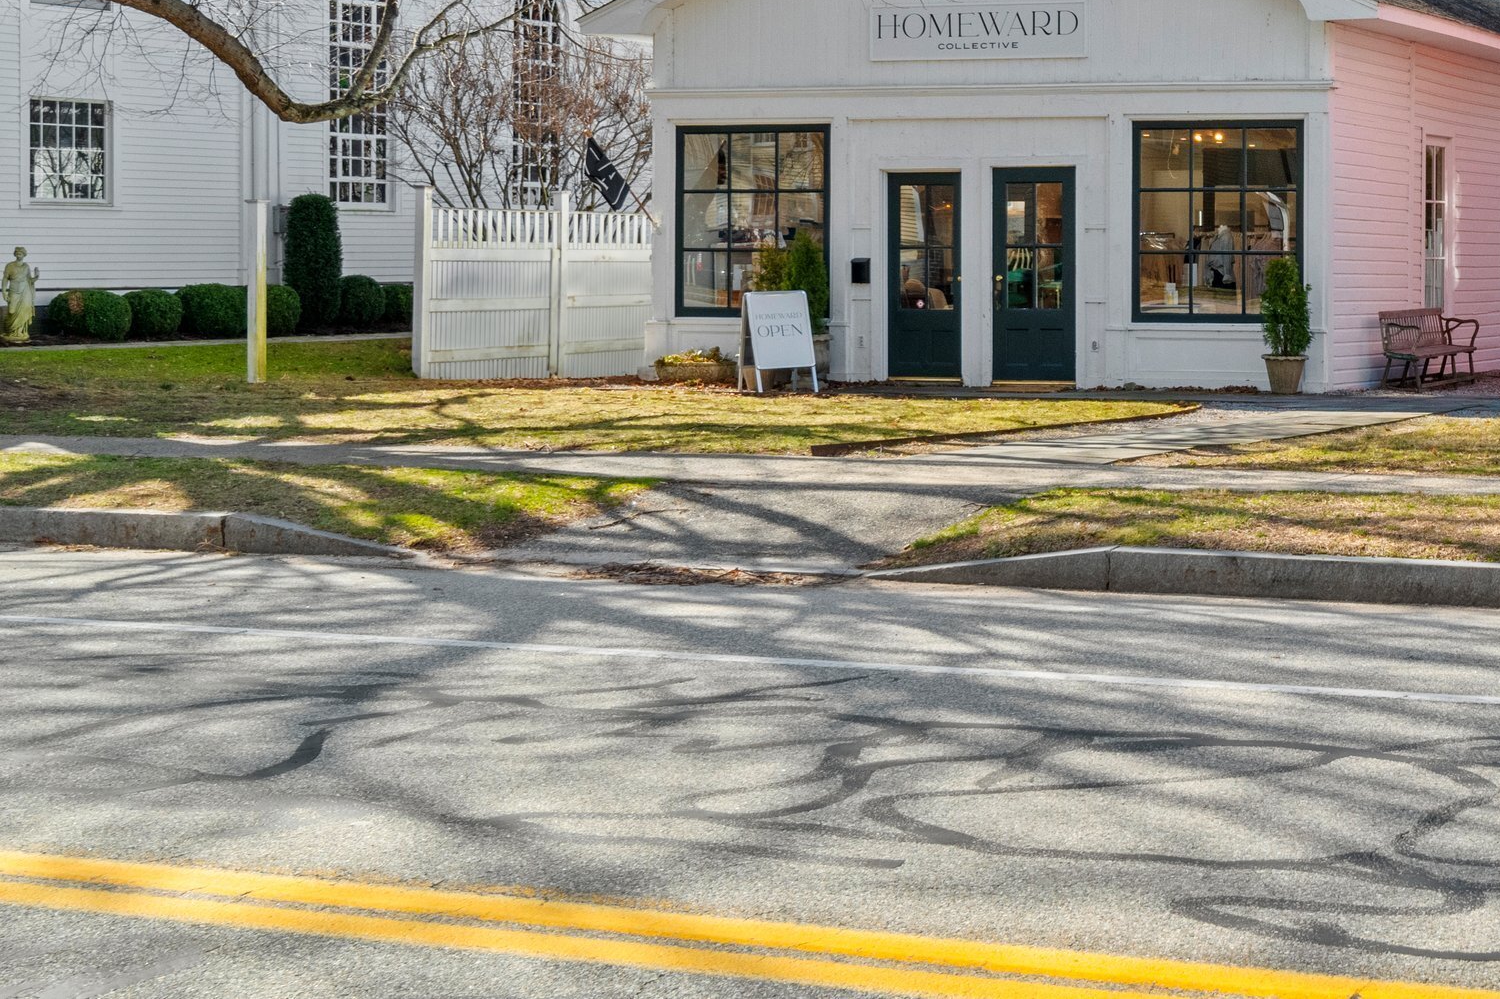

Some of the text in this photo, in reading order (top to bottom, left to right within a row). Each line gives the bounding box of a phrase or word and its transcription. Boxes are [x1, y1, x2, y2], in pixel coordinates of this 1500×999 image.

[877, 10, 1079, 39] HOMEWARD
[937, 41, 1019, 50] COLLECTIVE
[755, 312, 803, 321] HOMEWARD
[757, 323, 803, 338] OPEN
